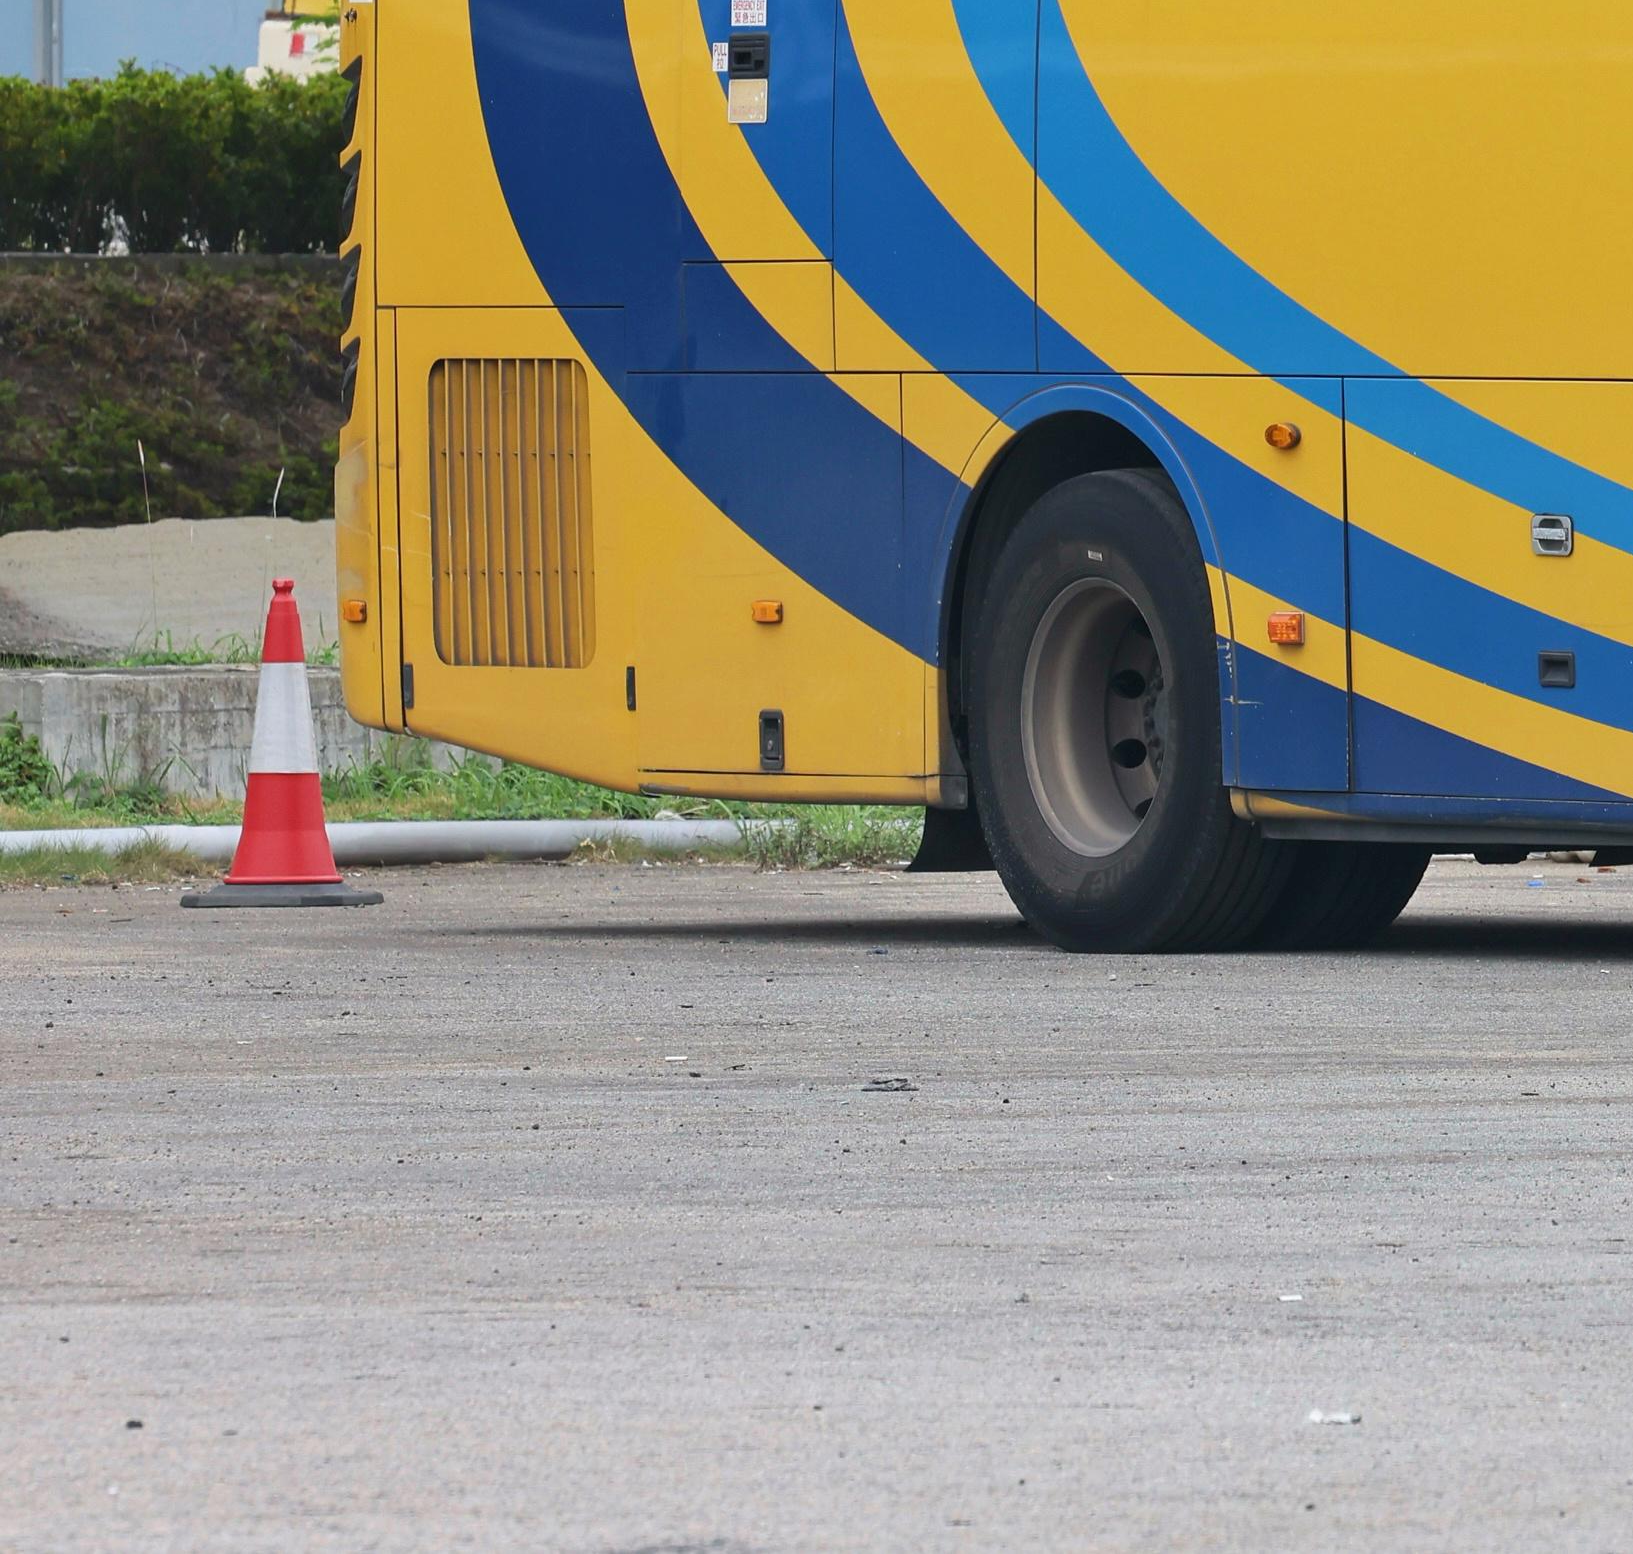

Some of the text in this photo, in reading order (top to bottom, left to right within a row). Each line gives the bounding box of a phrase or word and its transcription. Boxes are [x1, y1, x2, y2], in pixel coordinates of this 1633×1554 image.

[733, 0, 765, 10] EMERGENCY EXIT
[735, 12, 764, 23] 緊急出口
[714, 44, 727, 56] PULL
